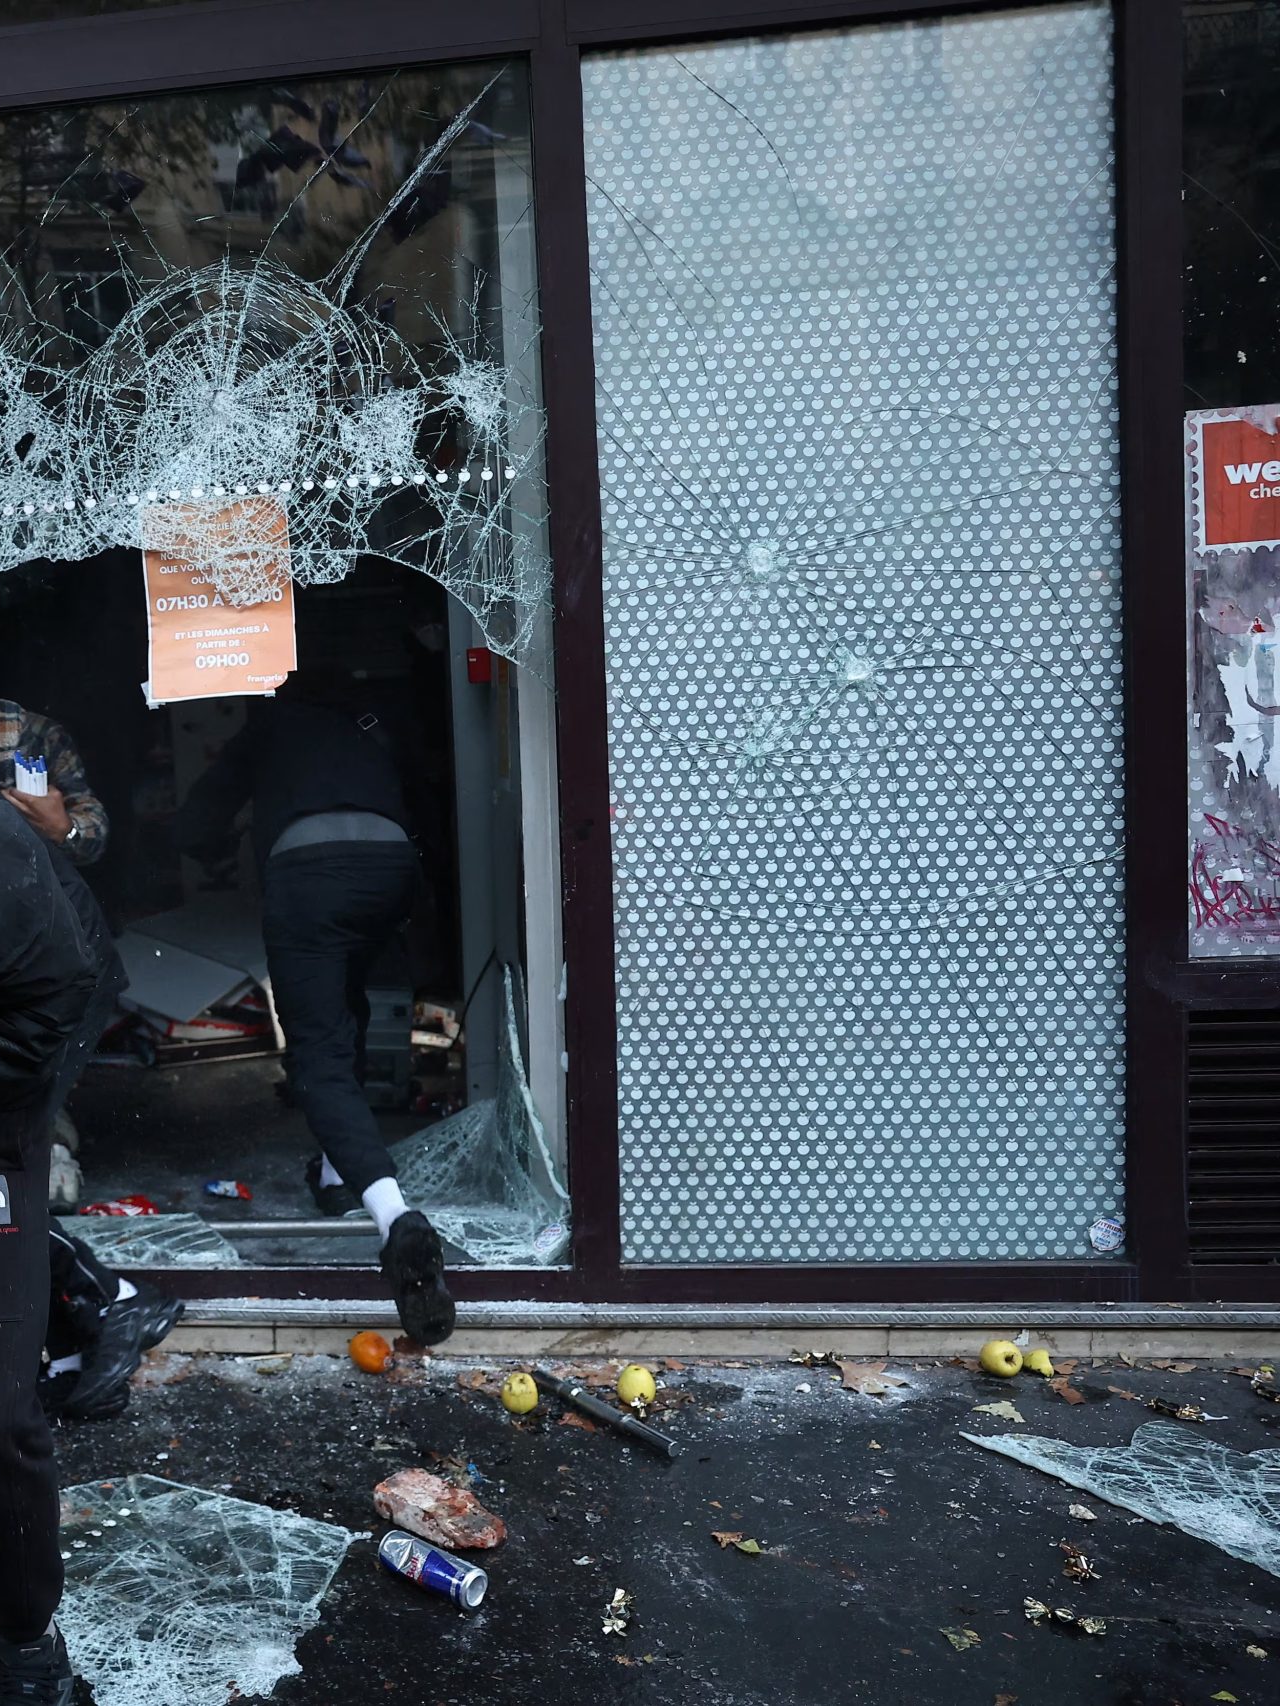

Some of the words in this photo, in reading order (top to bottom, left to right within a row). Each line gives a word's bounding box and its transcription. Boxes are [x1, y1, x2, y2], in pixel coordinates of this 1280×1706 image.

[159, 565, 179, 575] QUE
[156, 594, 209, 613] 07H30
[175, 631, 186, 640] ET
[187, 629, 203, 639] LES
[204, 626, 261, 638] DIMANCHES
[262, 623, 270, 633] À
[196, 640, 227, 649] PARTIR
[228, 639, 241, 648] DE
[195, 652, 250, 669] 09H00
[247, 673, 284, 686] franprix
